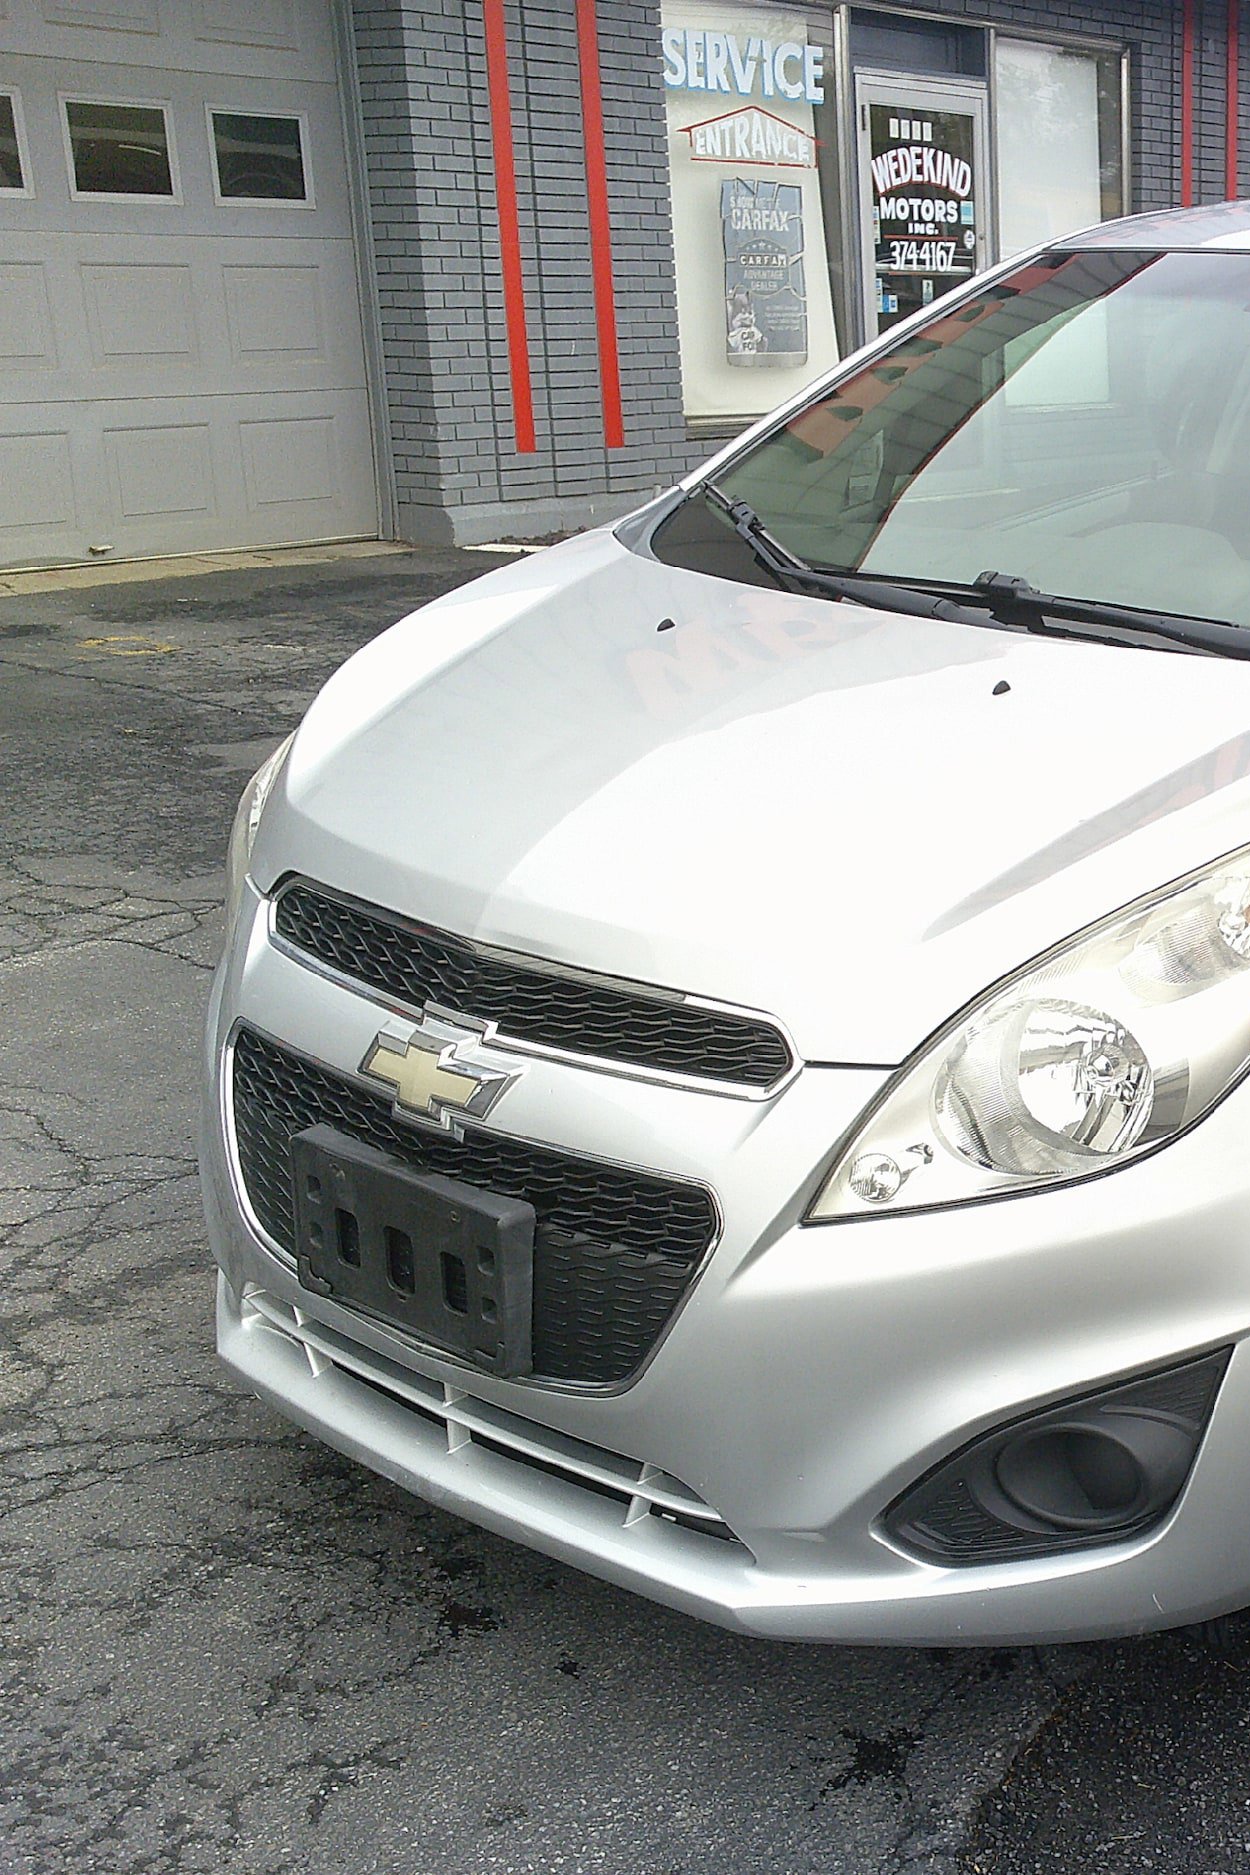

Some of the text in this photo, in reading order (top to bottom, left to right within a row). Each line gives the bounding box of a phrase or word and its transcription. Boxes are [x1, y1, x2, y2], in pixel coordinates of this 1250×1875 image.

[661, 27, 826, 104] SERVICE
[694, 111, 810, 162] ENTRANCE
[871, 146, 973, 197] WEDEKIND
[731, 208, 789, 232] CARFAX
[880, 197, 958, 223] MOTORS
[908, 223, 939, 235] INC.
[740, 254, 787, 266] CARFAX
[889, 241, 956, 272] 374-4167
